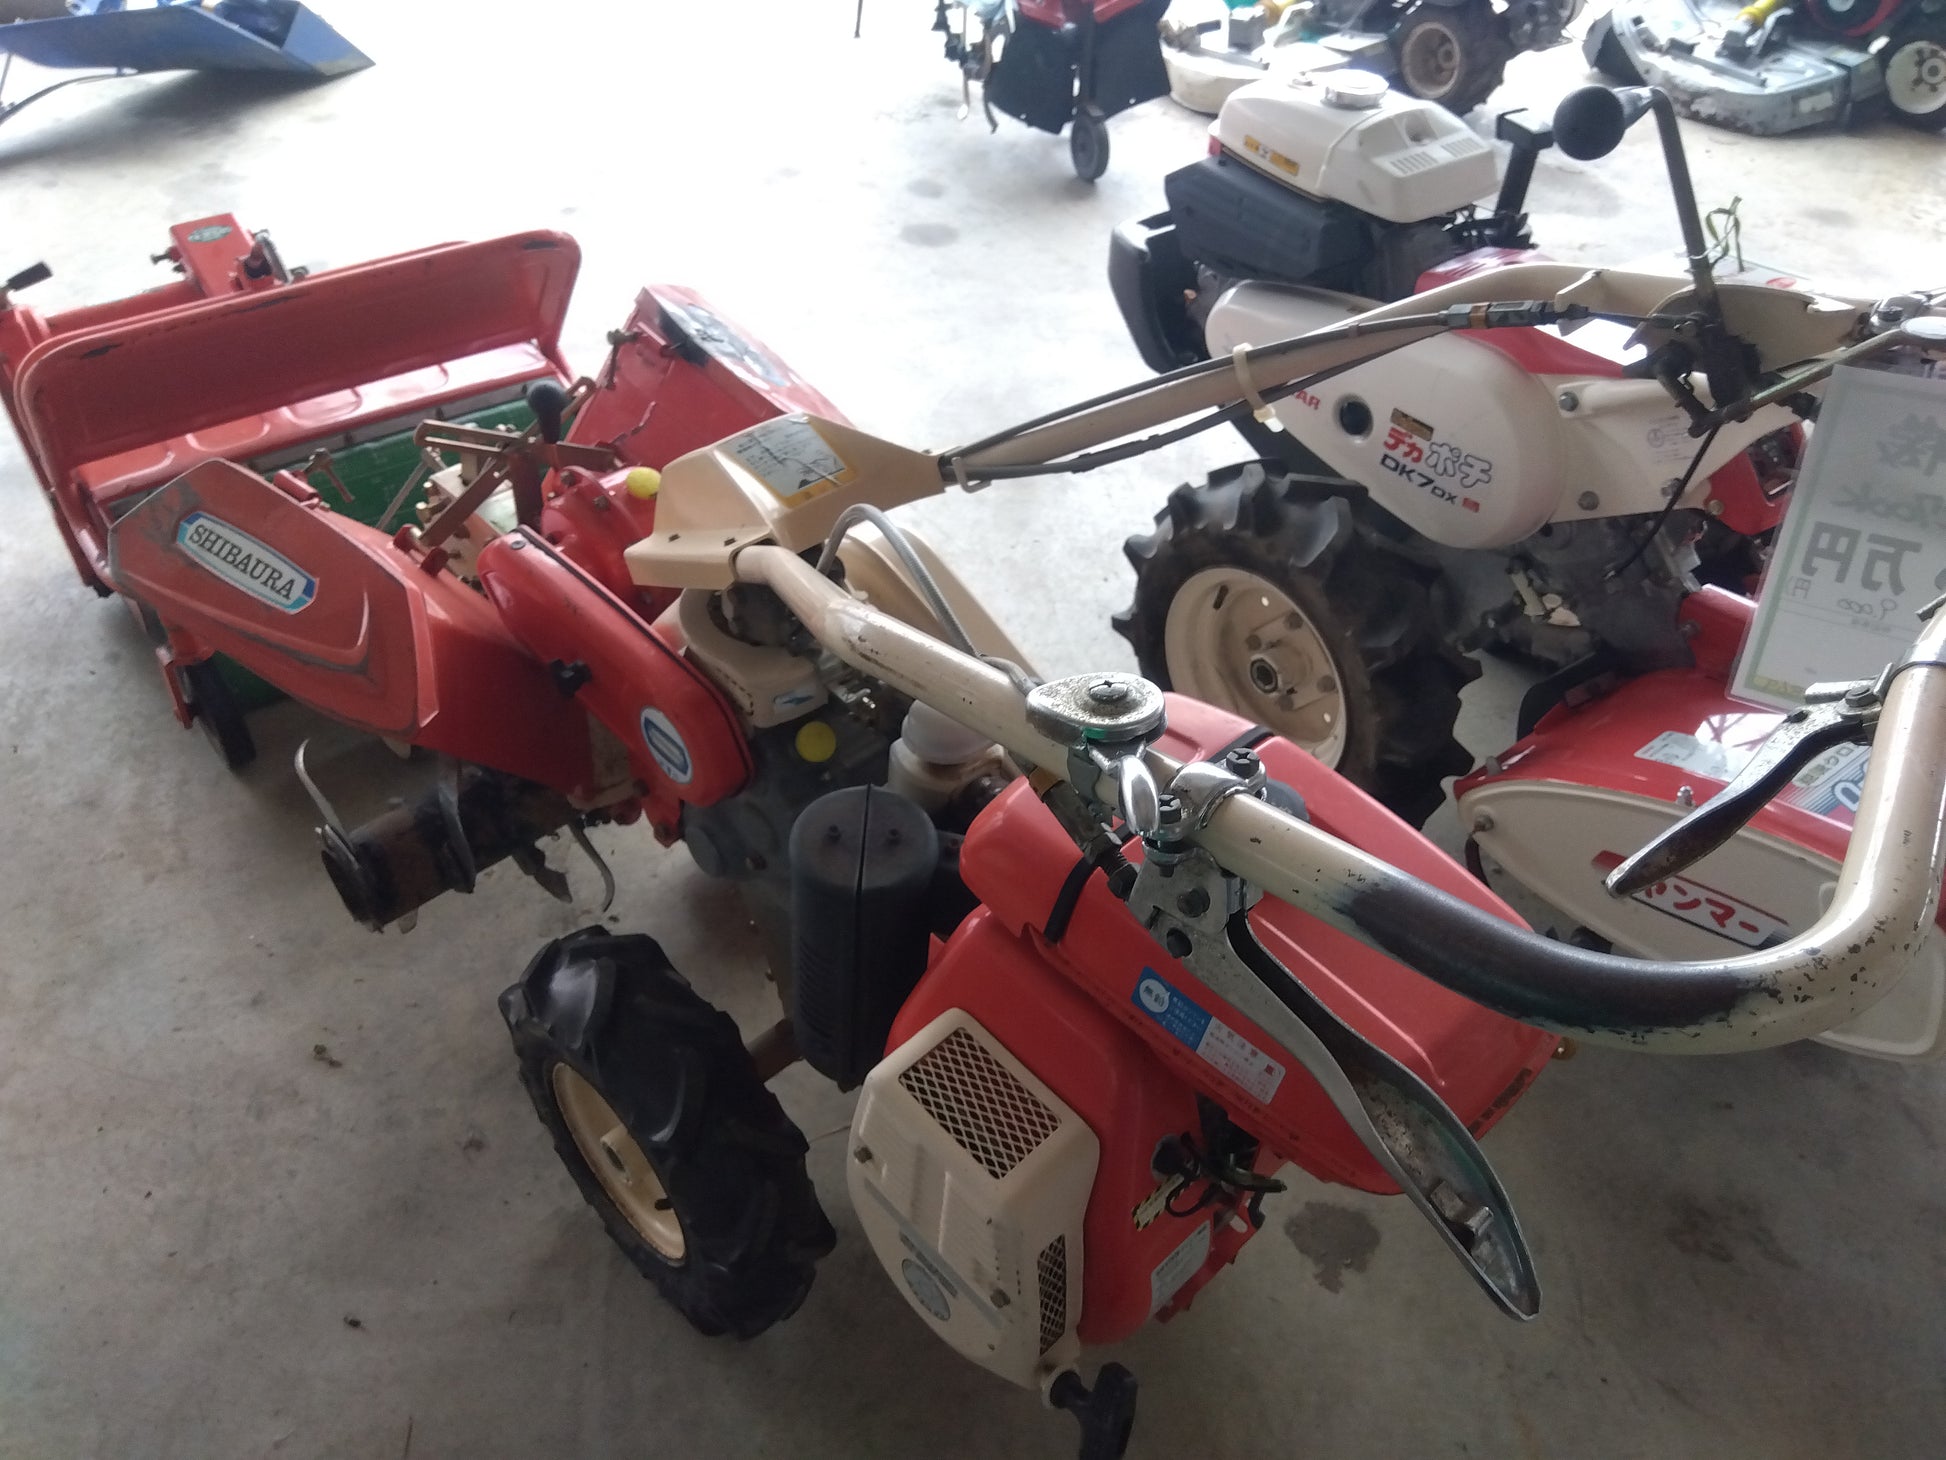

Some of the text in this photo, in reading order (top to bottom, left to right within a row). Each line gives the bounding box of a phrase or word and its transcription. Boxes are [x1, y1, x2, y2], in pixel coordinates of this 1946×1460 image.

[1383, 426, 1493, 489] デカポチ
[189, 524, 296, 600] SHIBAURA
